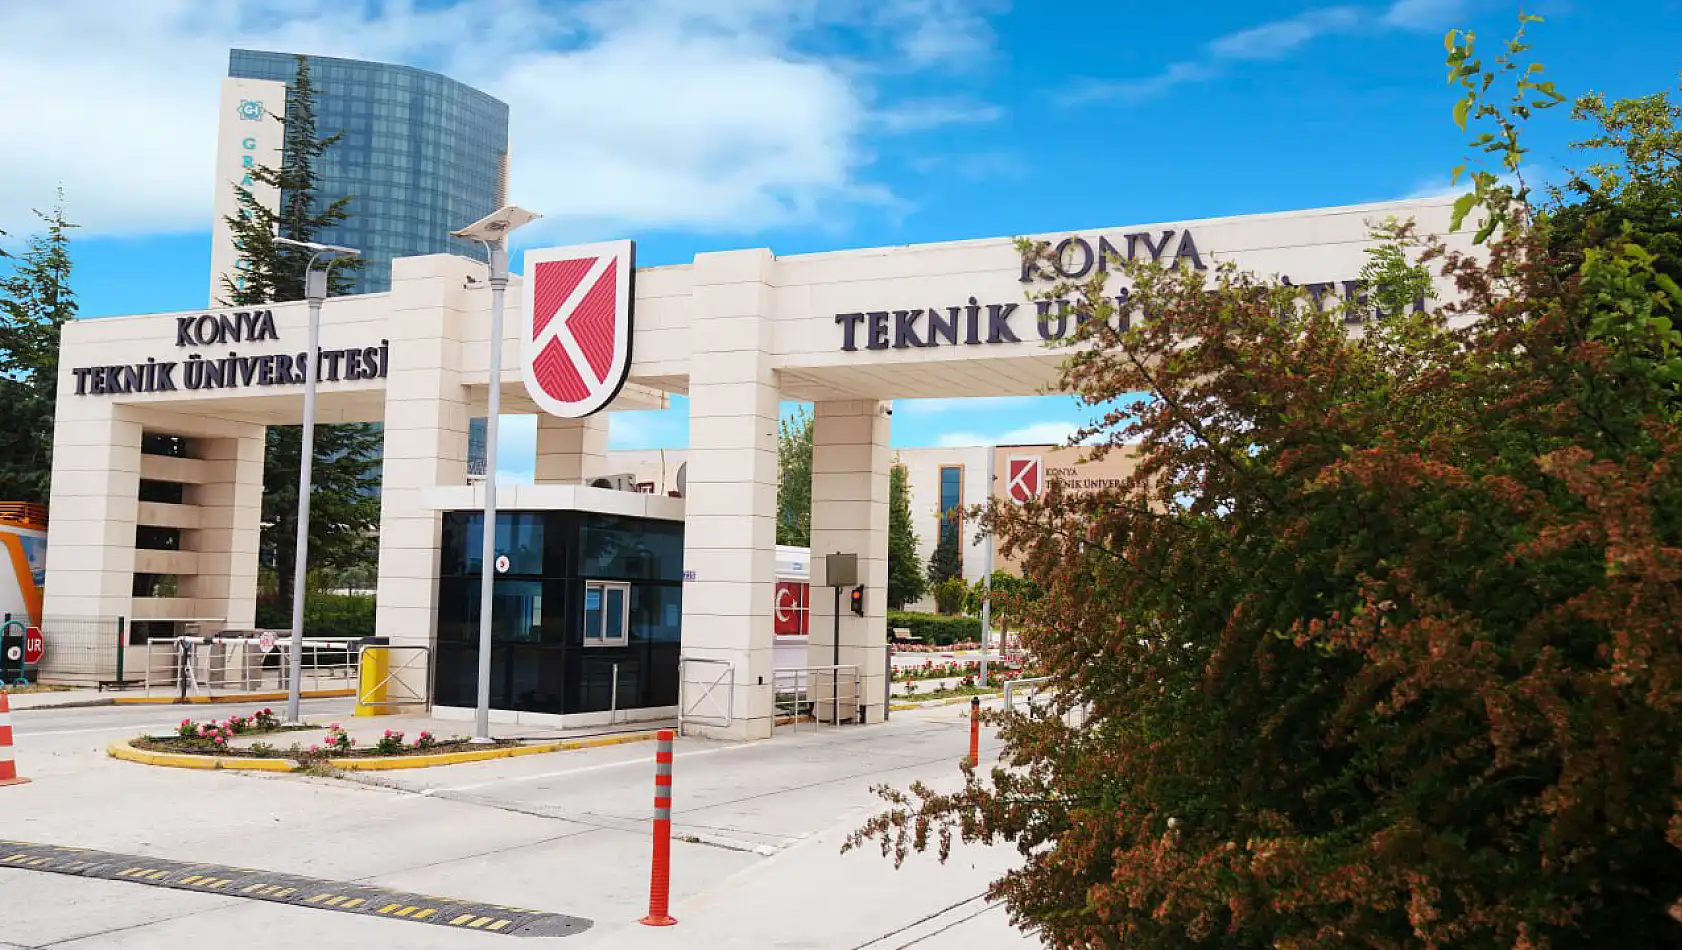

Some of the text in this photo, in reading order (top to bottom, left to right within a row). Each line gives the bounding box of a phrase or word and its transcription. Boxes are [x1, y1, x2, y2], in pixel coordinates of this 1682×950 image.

[175, 310, 279, 347] KONYA
[835, 296, 1021, 351] TEKNİK
[73, 357, 179, 396] TEKNİK
